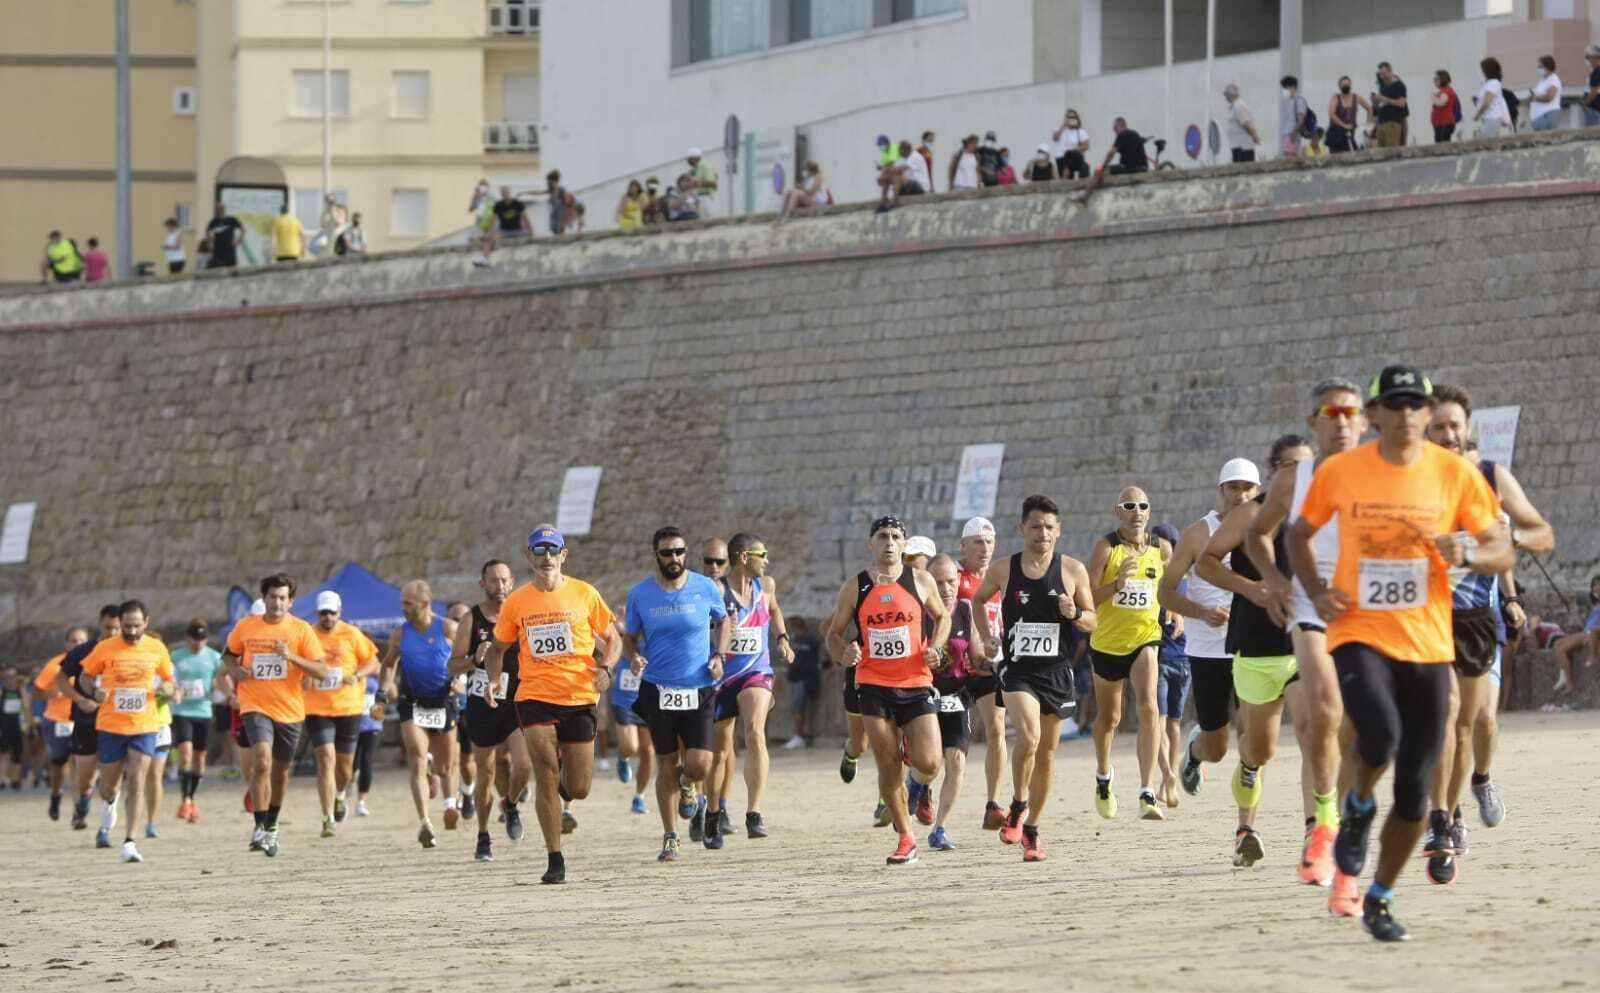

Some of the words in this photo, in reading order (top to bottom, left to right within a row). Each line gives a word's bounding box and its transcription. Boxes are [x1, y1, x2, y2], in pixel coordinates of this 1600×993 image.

[1118, 591, 1147, 606] 255
[1368, 580, 1417, 604] 288
[867, 611, 914, 626] ASFAS
[534, 636, 567, 654] 298
[730, 639, 757, 652] 272
[873, 640, 905, 657] 289
[1020, 637, 1052, 653] 270
[256, 664, 283, 677] 279
[623, 678, 640, 688] 25
[118, 698, 143, 710] 280
[663, 693, 691, 707] 281
[941, 701, 958, 710] 52
[417, 712, 442, 725] 256
